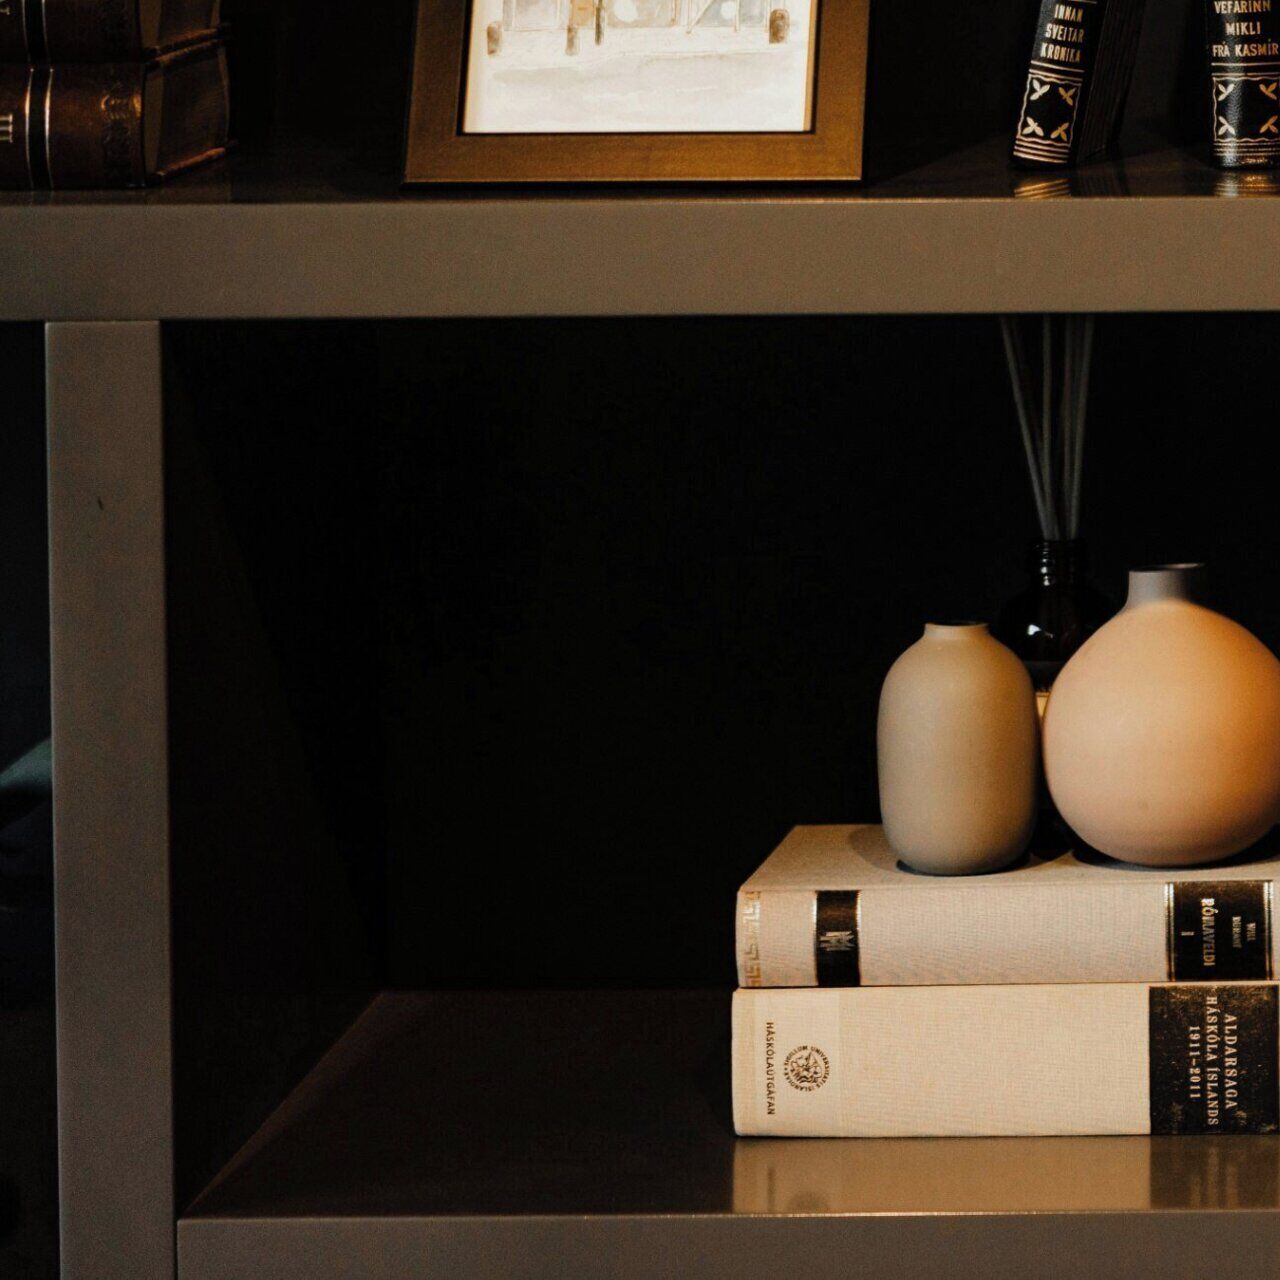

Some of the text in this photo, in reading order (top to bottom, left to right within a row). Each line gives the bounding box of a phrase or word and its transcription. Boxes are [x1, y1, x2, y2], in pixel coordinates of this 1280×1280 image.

[1054, 3, 1084, 23] INNAN
[1214, 0, 1271, 15] VEFARINN
[1046, 22, 1086, 43] SVEITAR
[1225, 21, 1261, 36] MIKLI
[1213, 39, 1279, 58] FRÁ KASMÍR
[1206, 996, 1221, 1125] HÁSKÓLA ÍSLANDS
[1224, 1013, 1238, 1109] ALDARSAGA
